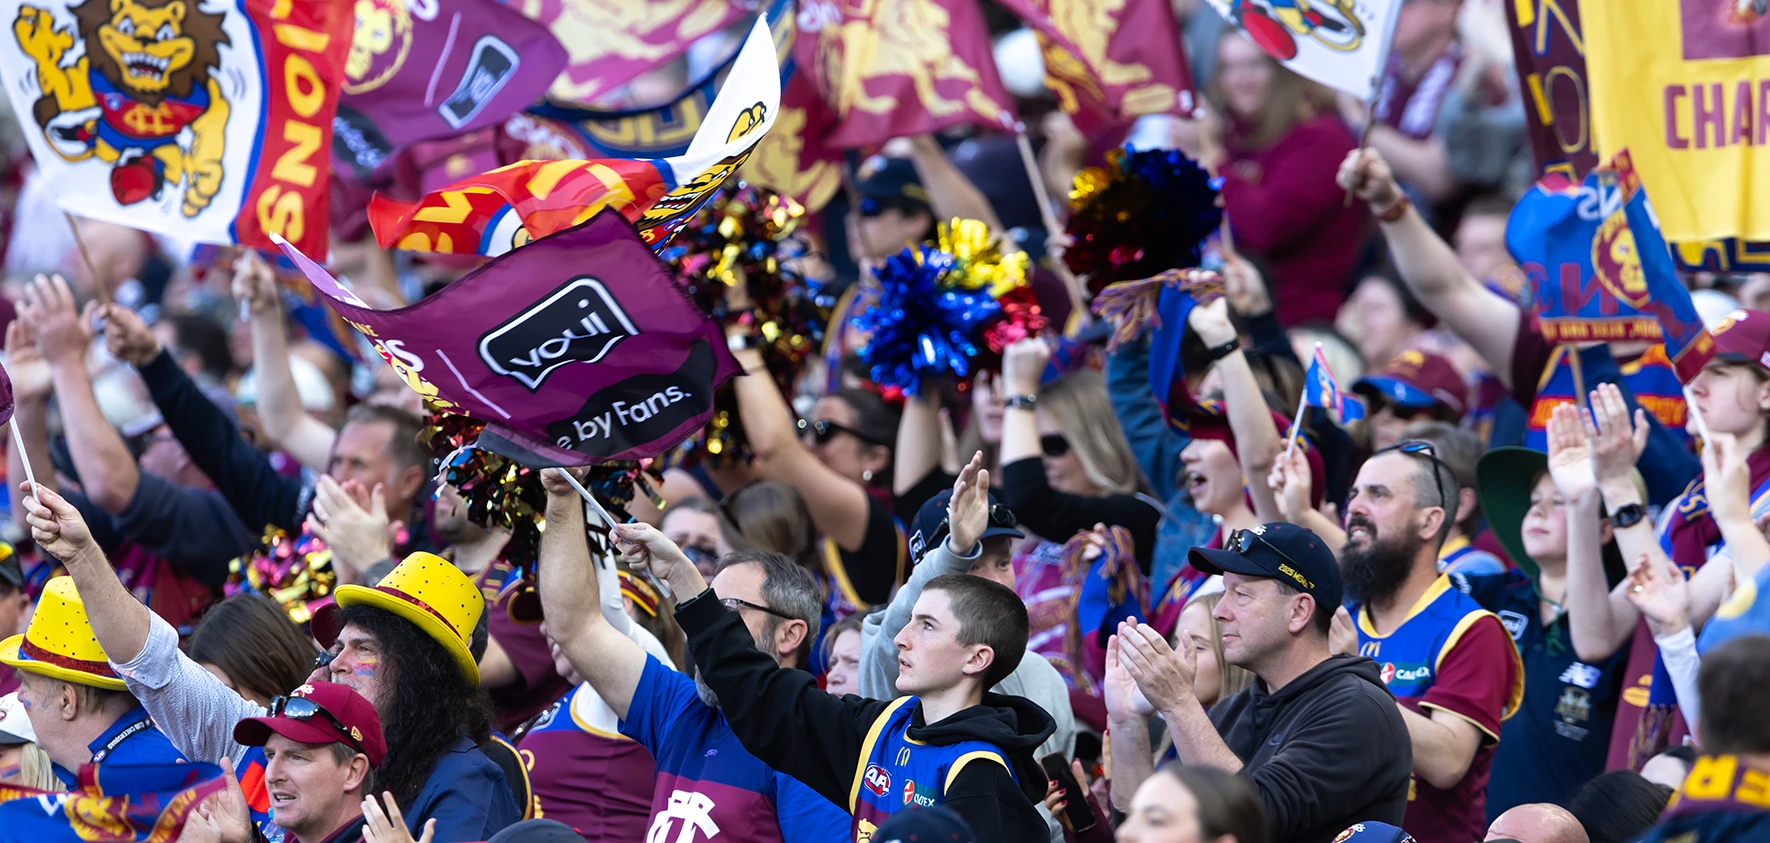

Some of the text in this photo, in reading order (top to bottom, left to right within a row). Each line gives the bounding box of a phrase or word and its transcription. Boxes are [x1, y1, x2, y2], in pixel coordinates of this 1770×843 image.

[257, 0, 330, 243] IONS
[509, 298, 611, 368] youi
[573, 385, 693, 439] by Fans.
[1278, 563, 1315, 589] 2025 MEMR
